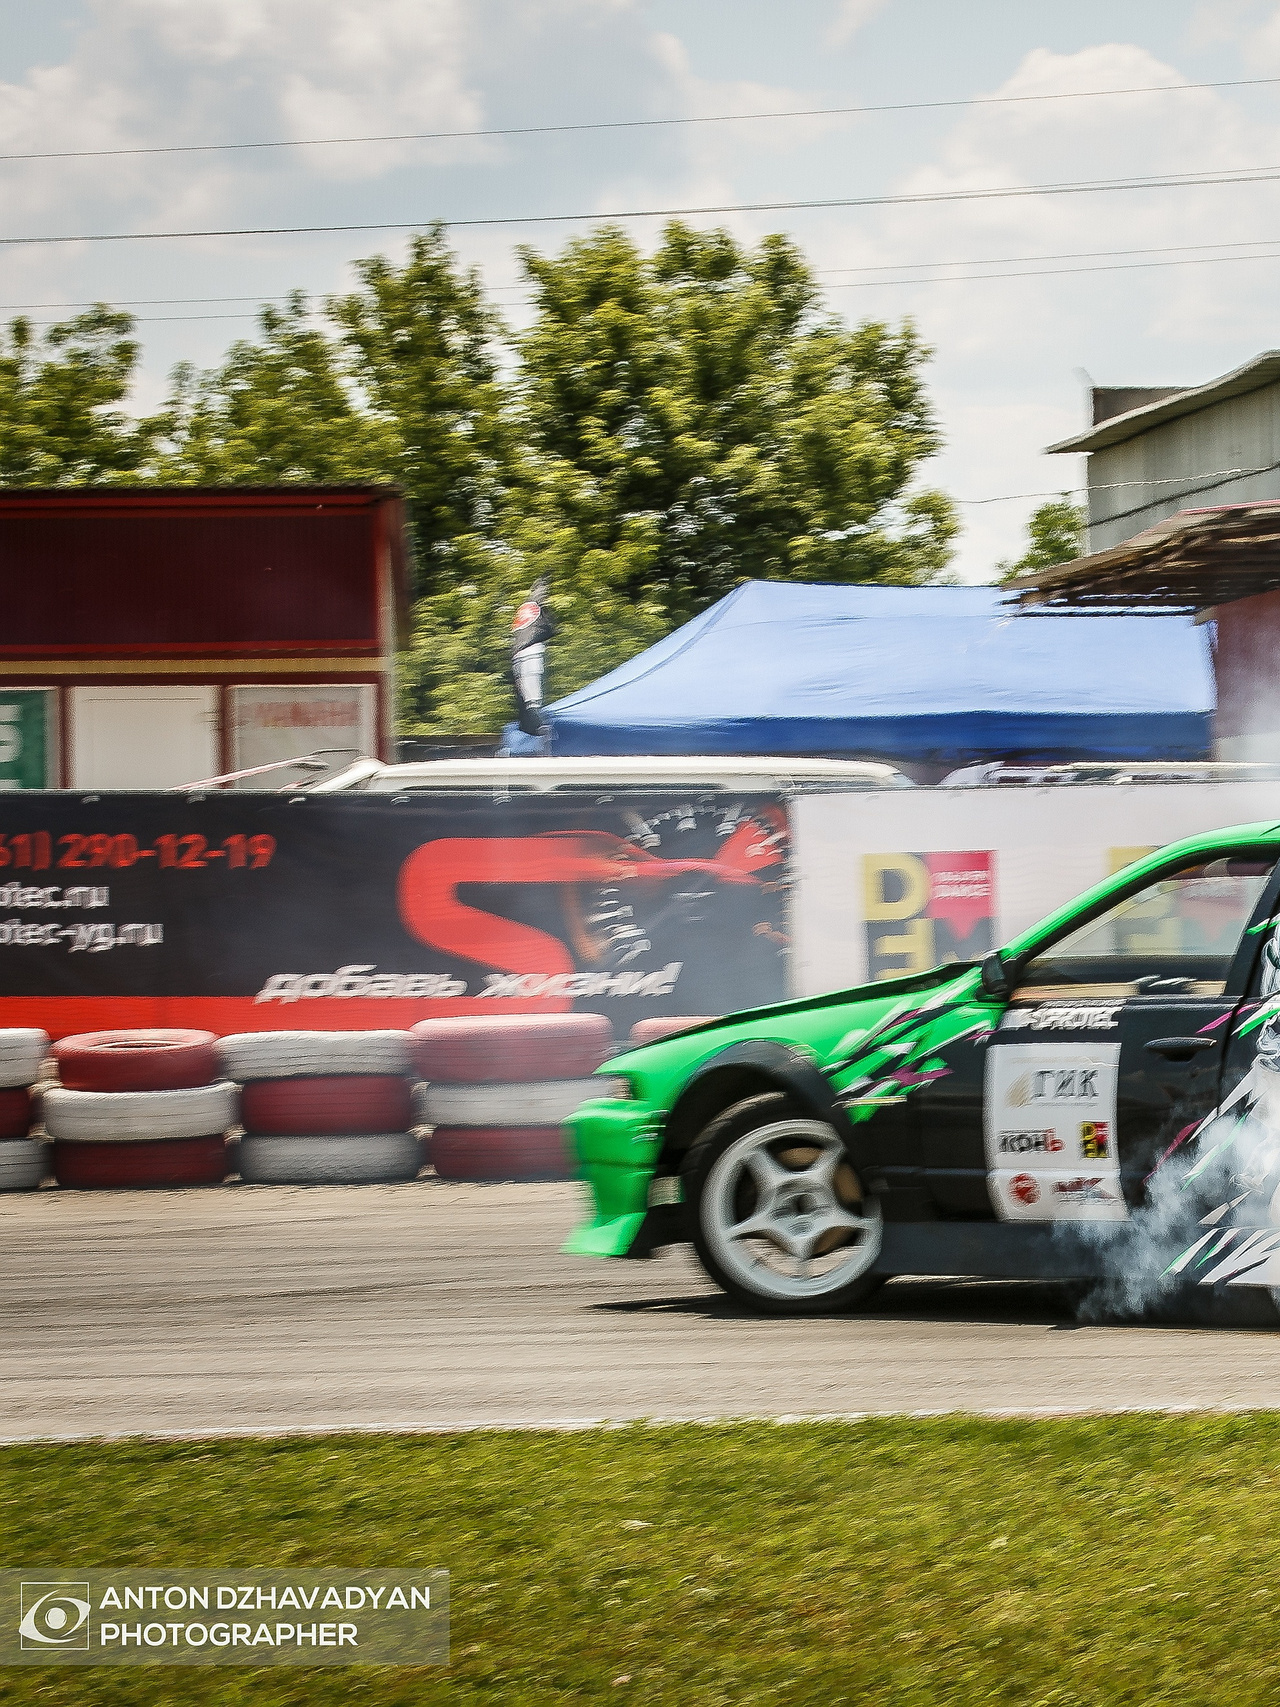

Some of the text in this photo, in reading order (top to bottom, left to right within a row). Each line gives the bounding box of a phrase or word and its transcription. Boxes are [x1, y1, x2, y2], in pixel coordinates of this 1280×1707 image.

[56, 833, 277, 870] 290-12-19
[253, 962, 684, 1006] добавь жизни!
[1032, 1069, 1099, 1098] ГИК
